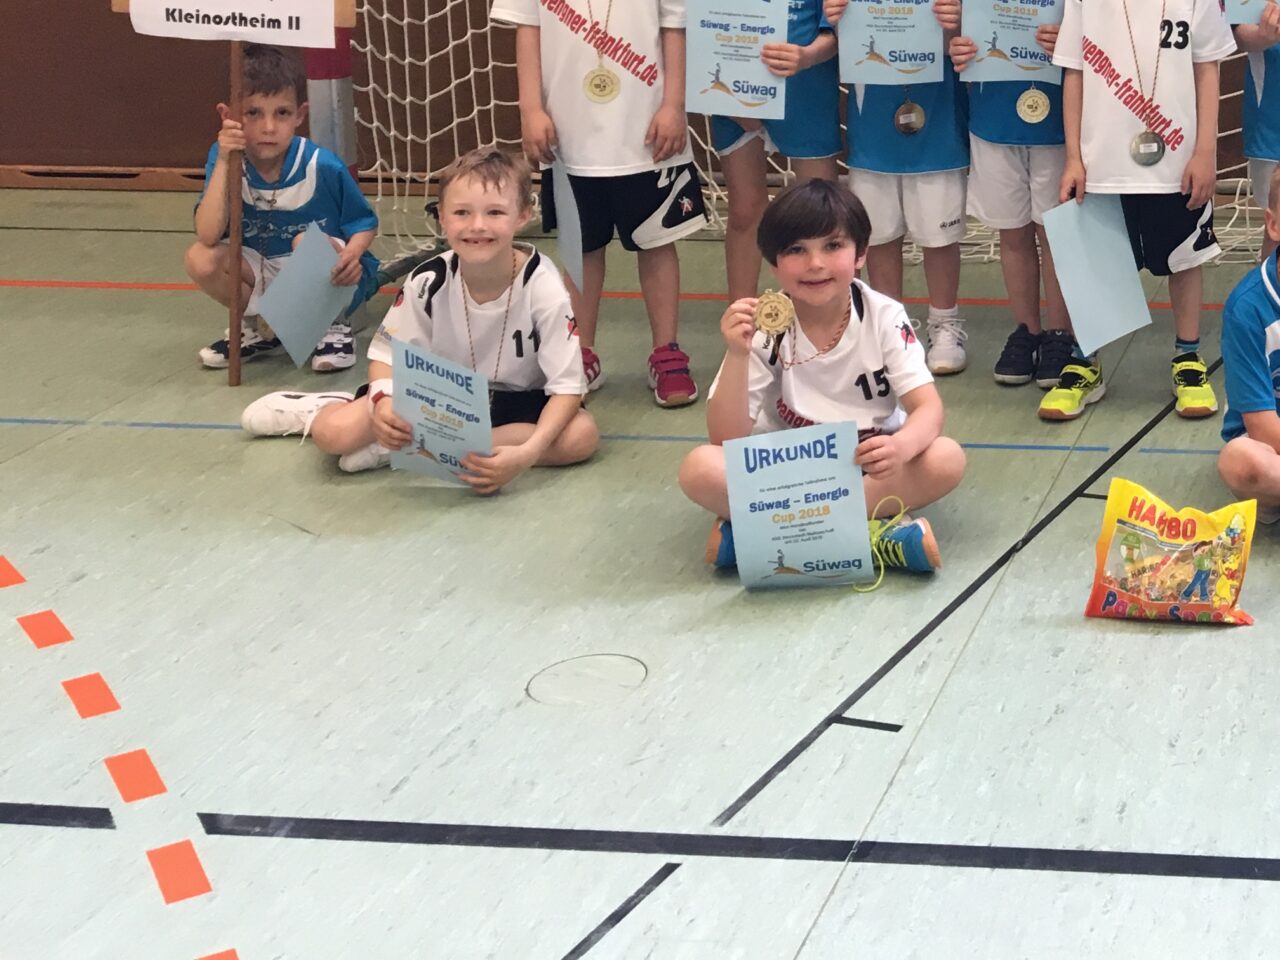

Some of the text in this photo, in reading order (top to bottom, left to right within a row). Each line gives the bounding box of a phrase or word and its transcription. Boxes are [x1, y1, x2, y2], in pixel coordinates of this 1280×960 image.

[165, 8, 282, 30] Kleinostheim
[867, 6, 913, 16] Cup 2018
[993, 4, 1039, 16] Cup 2018
[700, 20, 730, 32] Süwag
[740, 23, 775, 35] Energie
[1159, 19, 1191, 50] 23
[888, 50, 935, 64] Süwag
[733, 80, 777, 99] Süwag
[512, 326, 541, 358] 11
[404, 349, 474, 395] URKUNDE
[854, 366, 890, 401] 15
[405, 388, 436, 408] Süwag
[446, 403, 480, 424] Energie
[438, 412, 464, 430] 2018
[744, 433, 838, 474] URKUNDE
[749, 498, 791, 513] Süwag
[804, 487, 850, 504] Energie
[772, 505, 830, 524] Cup 2018
[803, 557, 862, 574] Süwag
